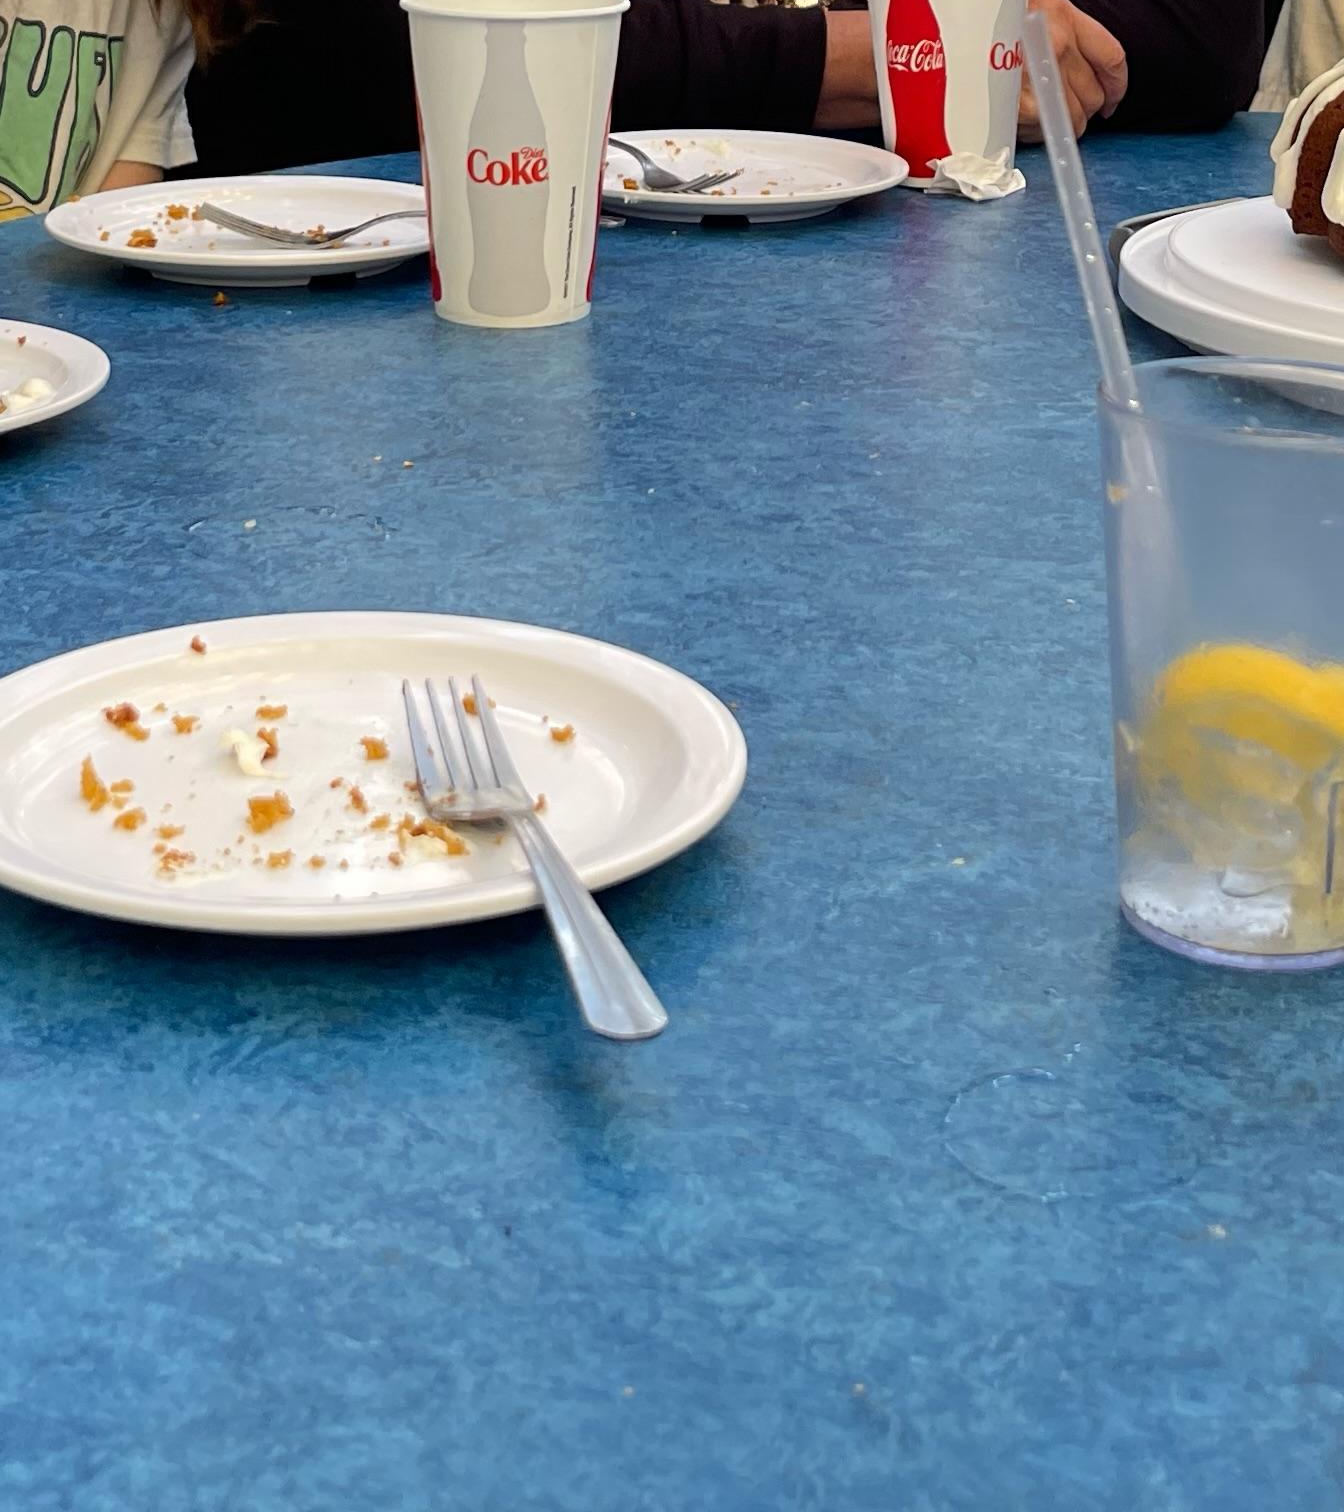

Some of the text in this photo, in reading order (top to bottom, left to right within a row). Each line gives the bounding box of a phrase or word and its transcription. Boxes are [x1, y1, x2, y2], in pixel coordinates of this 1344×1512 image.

[989, 38, 1024, 71] Cok
[467, 148, 549, 186] Coke
[520, 146, 545, 159] Diet
